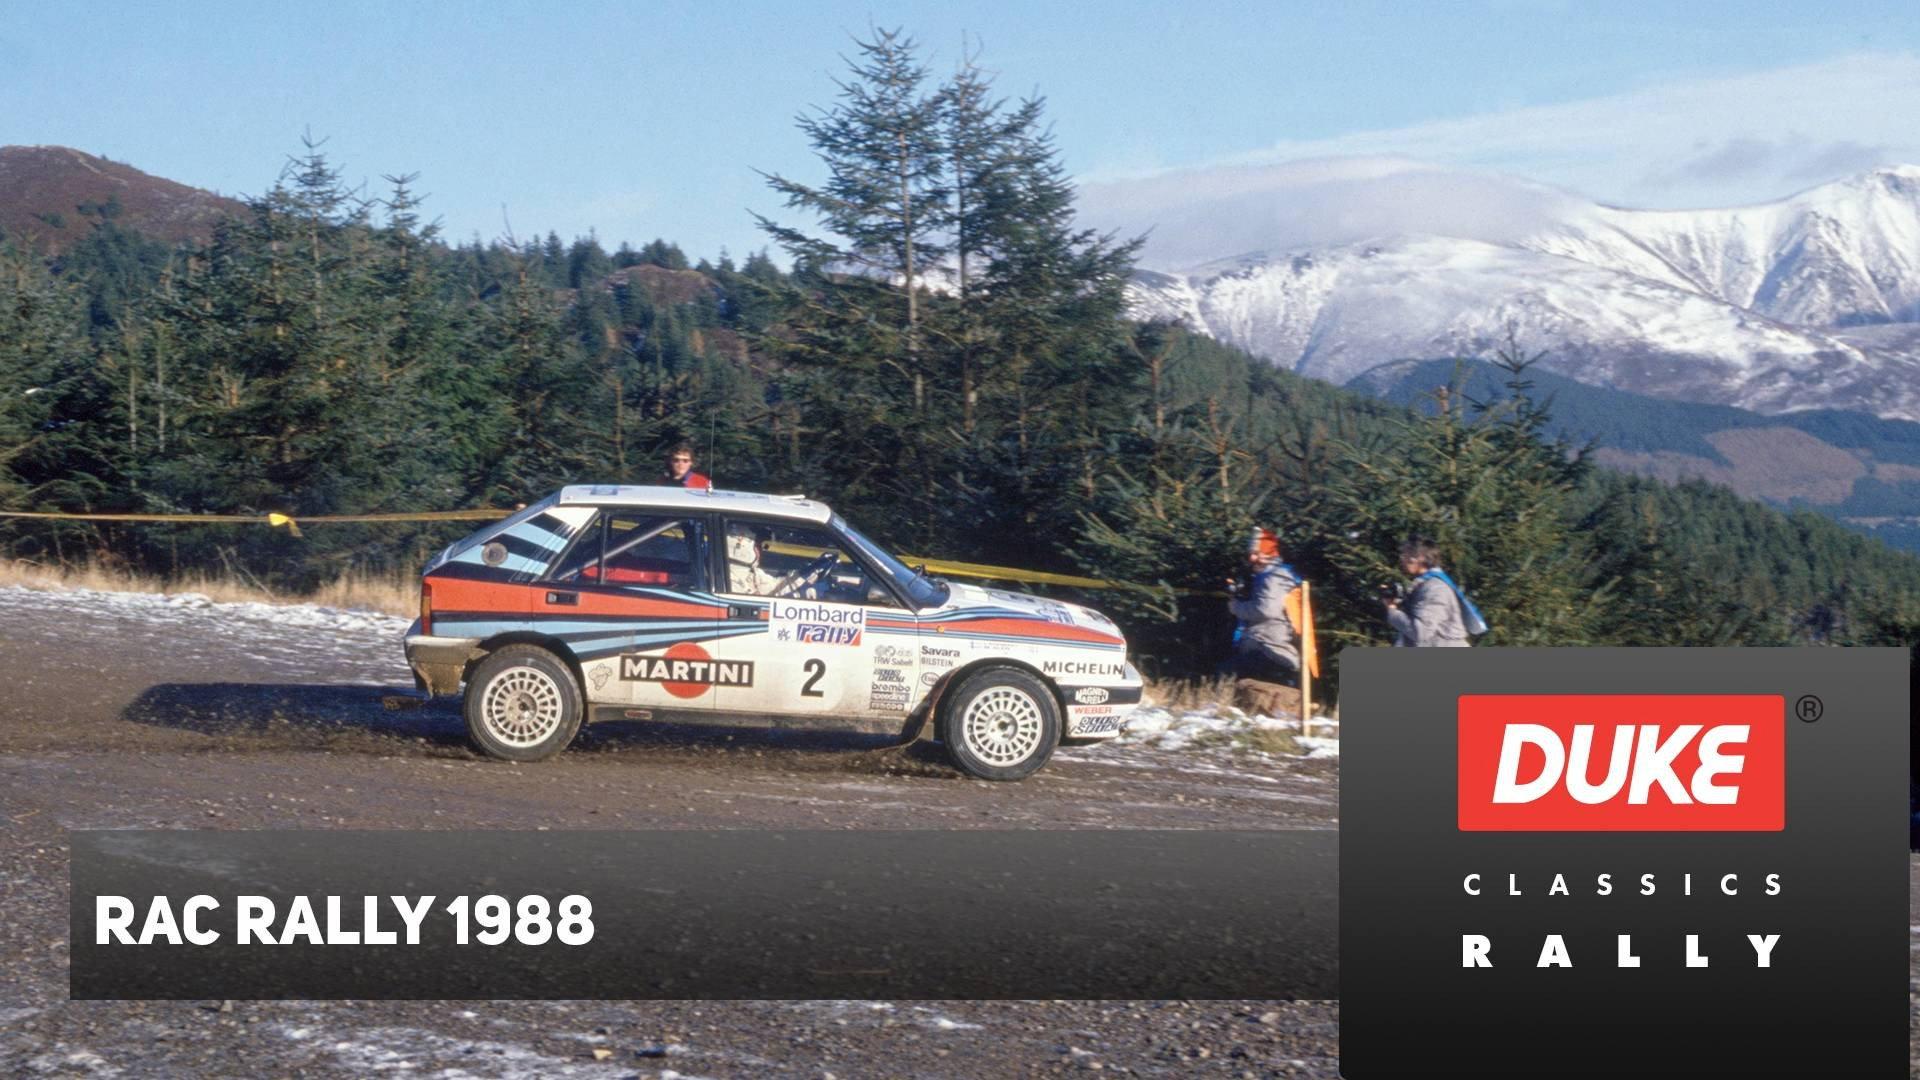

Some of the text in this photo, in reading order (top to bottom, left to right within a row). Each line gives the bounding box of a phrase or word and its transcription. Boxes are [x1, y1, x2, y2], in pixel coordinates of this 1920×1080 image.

[773, 602, 863, 624] Lombard
[799, 623, 860, 645] rally
[921, 646, 960, 658] Savara
[921, 657, 953, 667] BILSTEIN
[1043, 661, 1123, 675] MICHELIN
[624, 658, 750, 684] MARTINI
[801, 658, 826, 697] 2
[872, 681, 911, 692] brembo
[1074, 706, 1112, 714] WEBER
